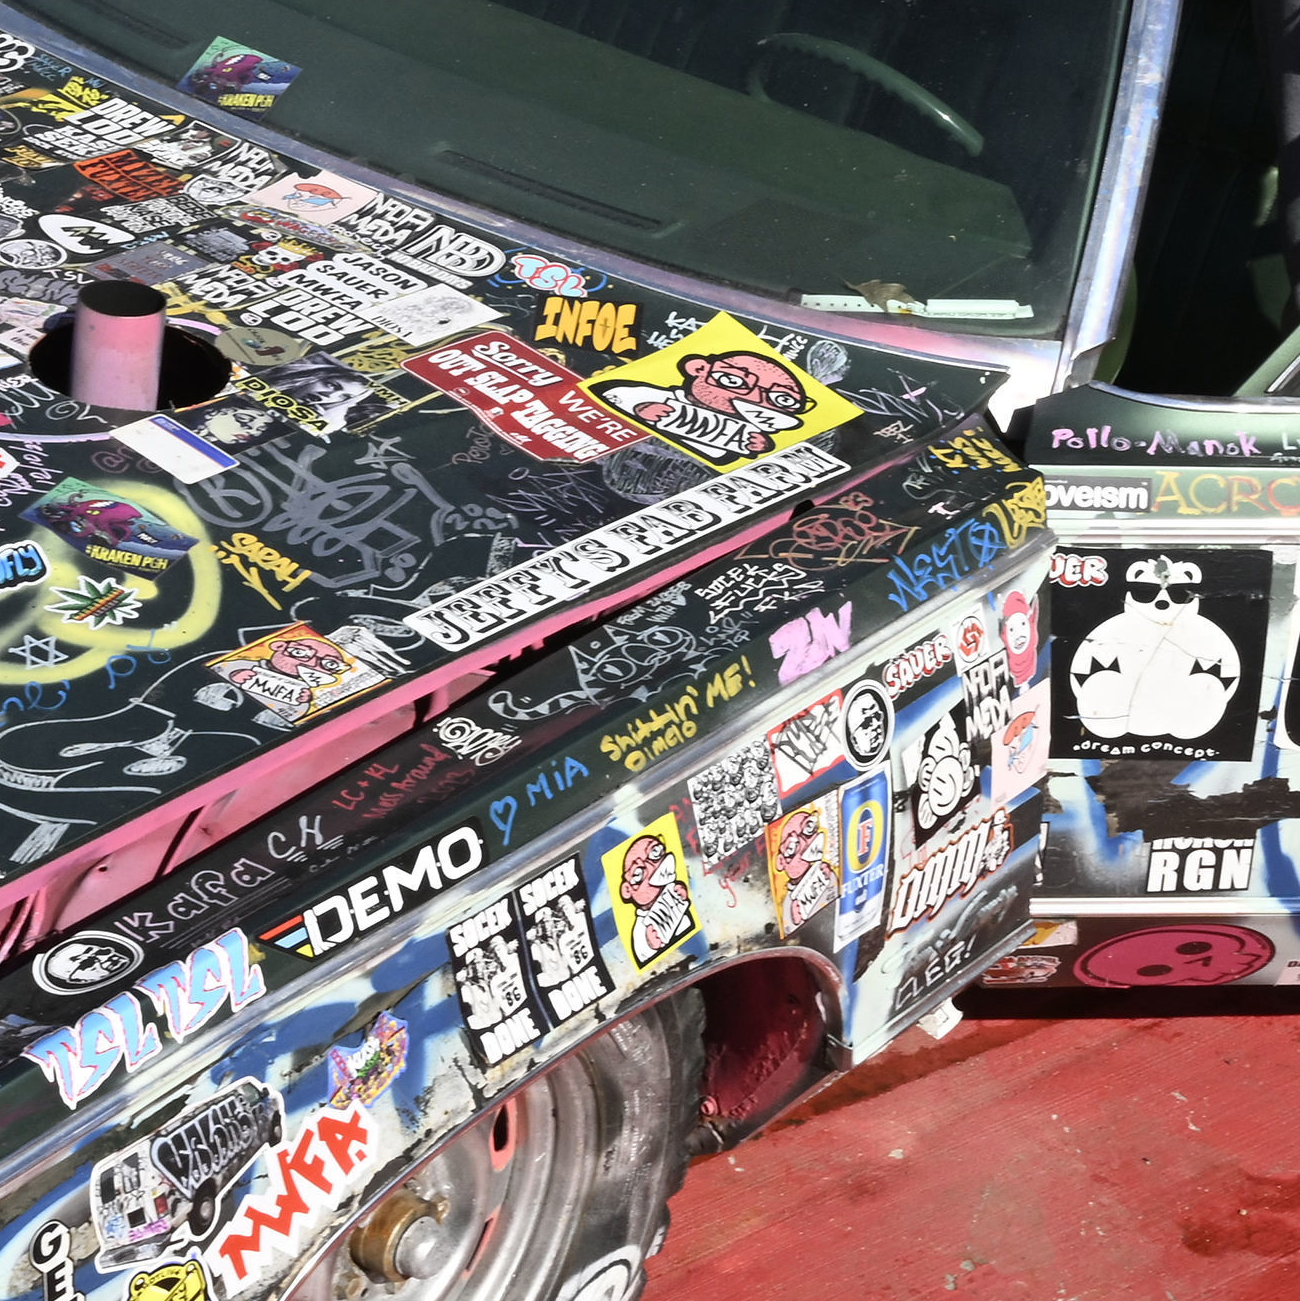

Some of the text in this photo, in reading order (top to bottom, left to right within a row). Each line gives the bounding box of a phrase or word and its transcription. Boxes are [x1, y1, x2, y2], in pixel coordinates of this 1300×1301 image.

[93, 98, 177, 138] DREW
[288, 273, 364, 312] MWFA
[316, 263, 390, 300] SAUER
[343, 254, 419, 291] JASON
[511, 254, 588, 297] TSL
[277, 287, 376, 336] DREW
[237, 376, 332, 435] DIOSA
[427, 350, 611, 463] OUT SLAP TAGGING
[474, 340, 639, 443] Sorry WE'RE
[670, 404, 752, 453] MWFA
[1045, 482, 1148, 510] oveism
[226, 532, 313, 593] SARAH
[410, 446, 842, 649] JEFFY'S FAB FARM
[251, 676, 297, 704] MWFA
[706, 655, 758, 709] ME!
[884, 634, 952, 699] SAUER
[303, 826, 485, 956] DEMO
[519, 857, 581, 916] SOCEK
[1147, 848, 1253, 893] RGN
[451, 898, 512, 958] SOCEK
[548, 972, 606, 1021] DONE
[480, 1011, 542, 1063] DONE
[218, 1107, 375, 1283] MWFA
